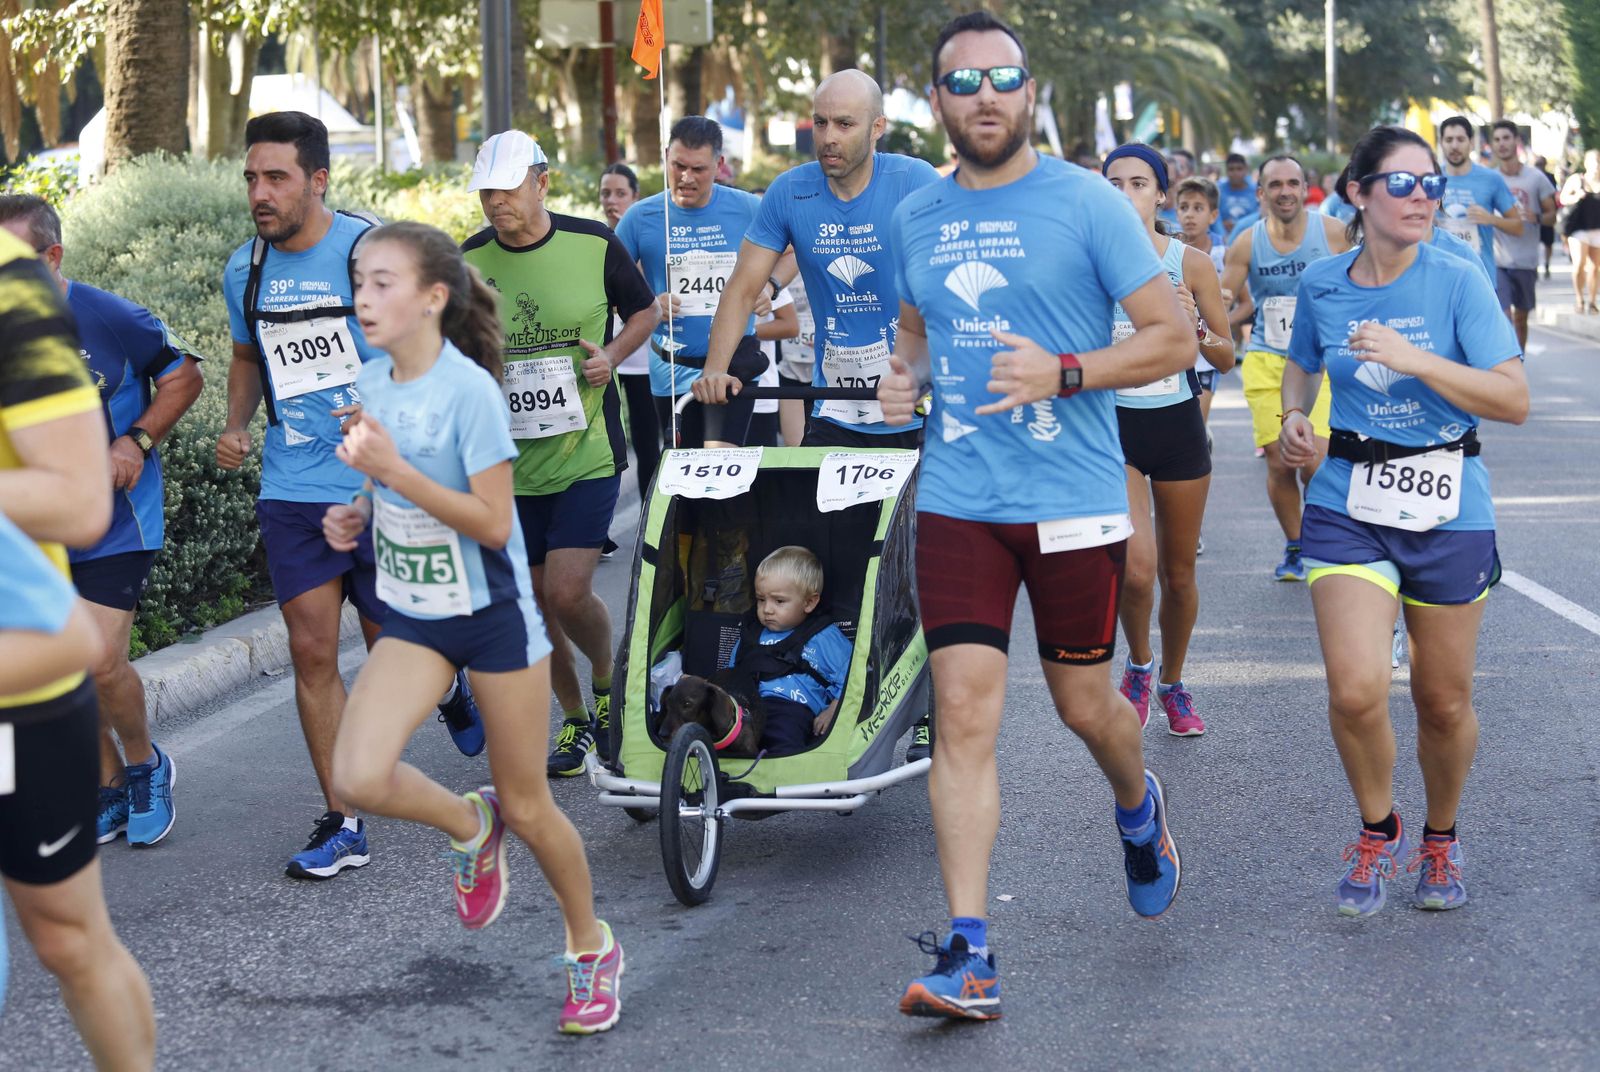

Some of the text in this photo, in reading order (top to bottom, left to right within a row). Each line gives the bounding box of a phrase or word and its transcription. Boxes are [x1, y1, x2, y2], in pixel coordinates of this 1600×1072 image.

[671, 226, 692, 237] 39º
[698, 234, 725, 242] URBANA
[819, 224, 844, 237] 39º
[940, 220, 969, 242] 39º
[851, 236, 878, 244] URBANA
[934, 237, 1020, 253] CARRERA URBANA
[812, 244, 883, 254] CIUDAD DE MÁLAGA
[929, 248, 1026, 266] CIUDAD DE MÁLAGA
[1258, 260, 1307, 277] nerja
[269, 279, 294, 295] 39º
[679, 277, 725, 295] 2440
[264, 295, 298, 303] CARRERA
[836, 291, 878, 303] Unicaja
[952, 315, 1010, 333] Unicaja
[506, 326, 581, 346] MEGUIS.org
[273, 331, 346, 367] 13091
[861, 344, 885, 355] URBANA
[864, 351, 889, 361] MÁLAGA
[503, 364, 515, 377] 9º
[517, 358, 568, 369] CARRERA URBANA
[548, 365, 572, 373] MÁLAGA
[509, 387, 567, 413] 8994
[1367, 398, 1420, 416] Unicaja
[680, 464, 742, 477] 1510
[836, 464, 896, 485] 1706
[1363, 460, 1452, 500] 15886
[378, 538, 454, 583] 21575
[901, 656, 919, 686] DELUXE
